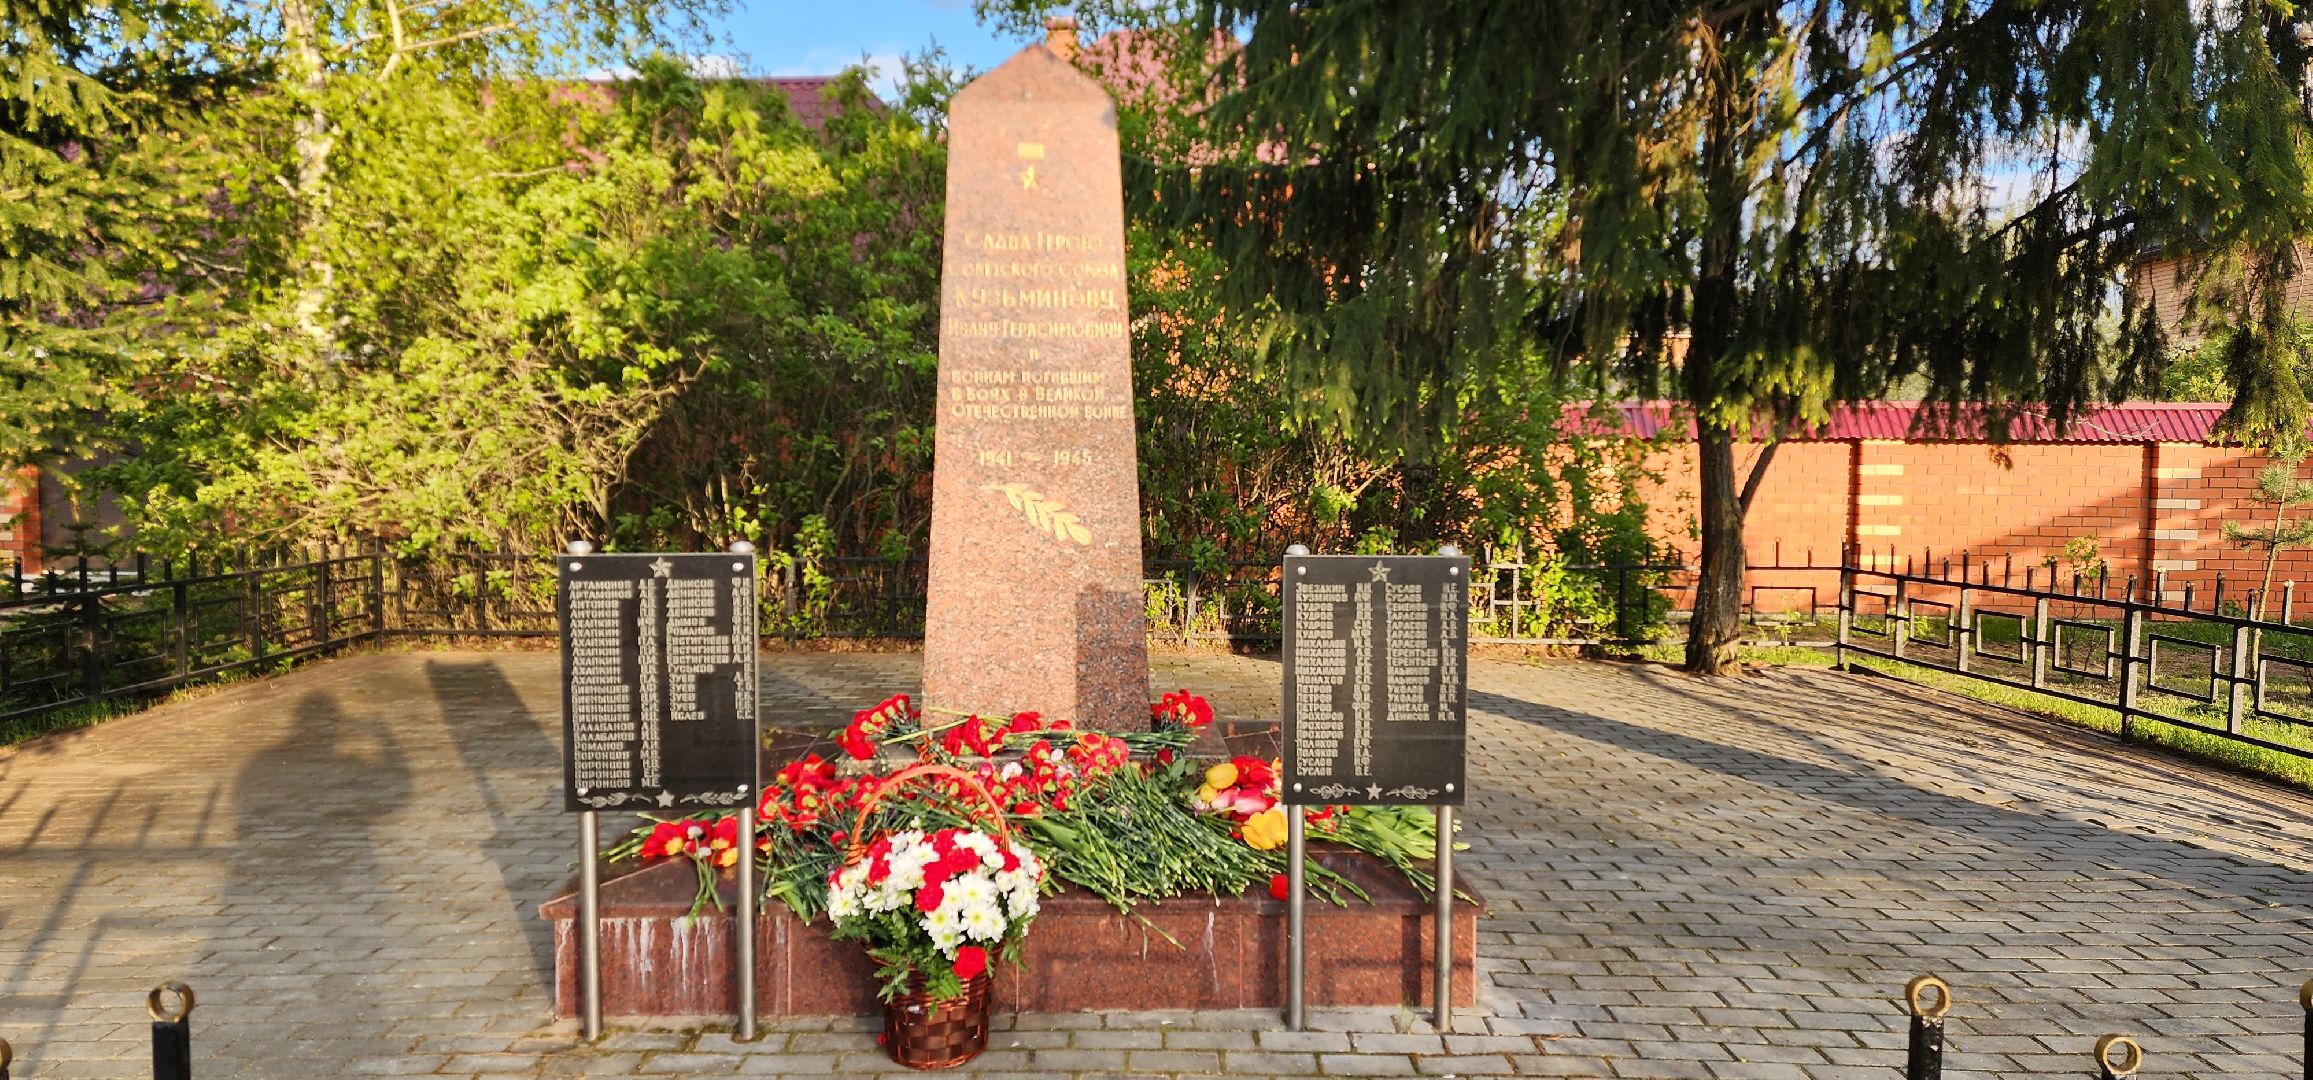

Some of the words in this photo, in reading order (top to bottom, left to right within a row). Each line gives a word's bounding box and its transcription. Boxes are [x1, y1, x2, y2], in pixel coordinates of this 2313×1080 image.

[951, 370, 1015, 384] ВОИНАМ
[979, 450, 1013, 466] 1941
[1054, 450, 1093, 466] 1945
[569, 581, 632, 590] АРТАМОНОВ
[570, 590, 632, 599] АРТАМОНОВ
